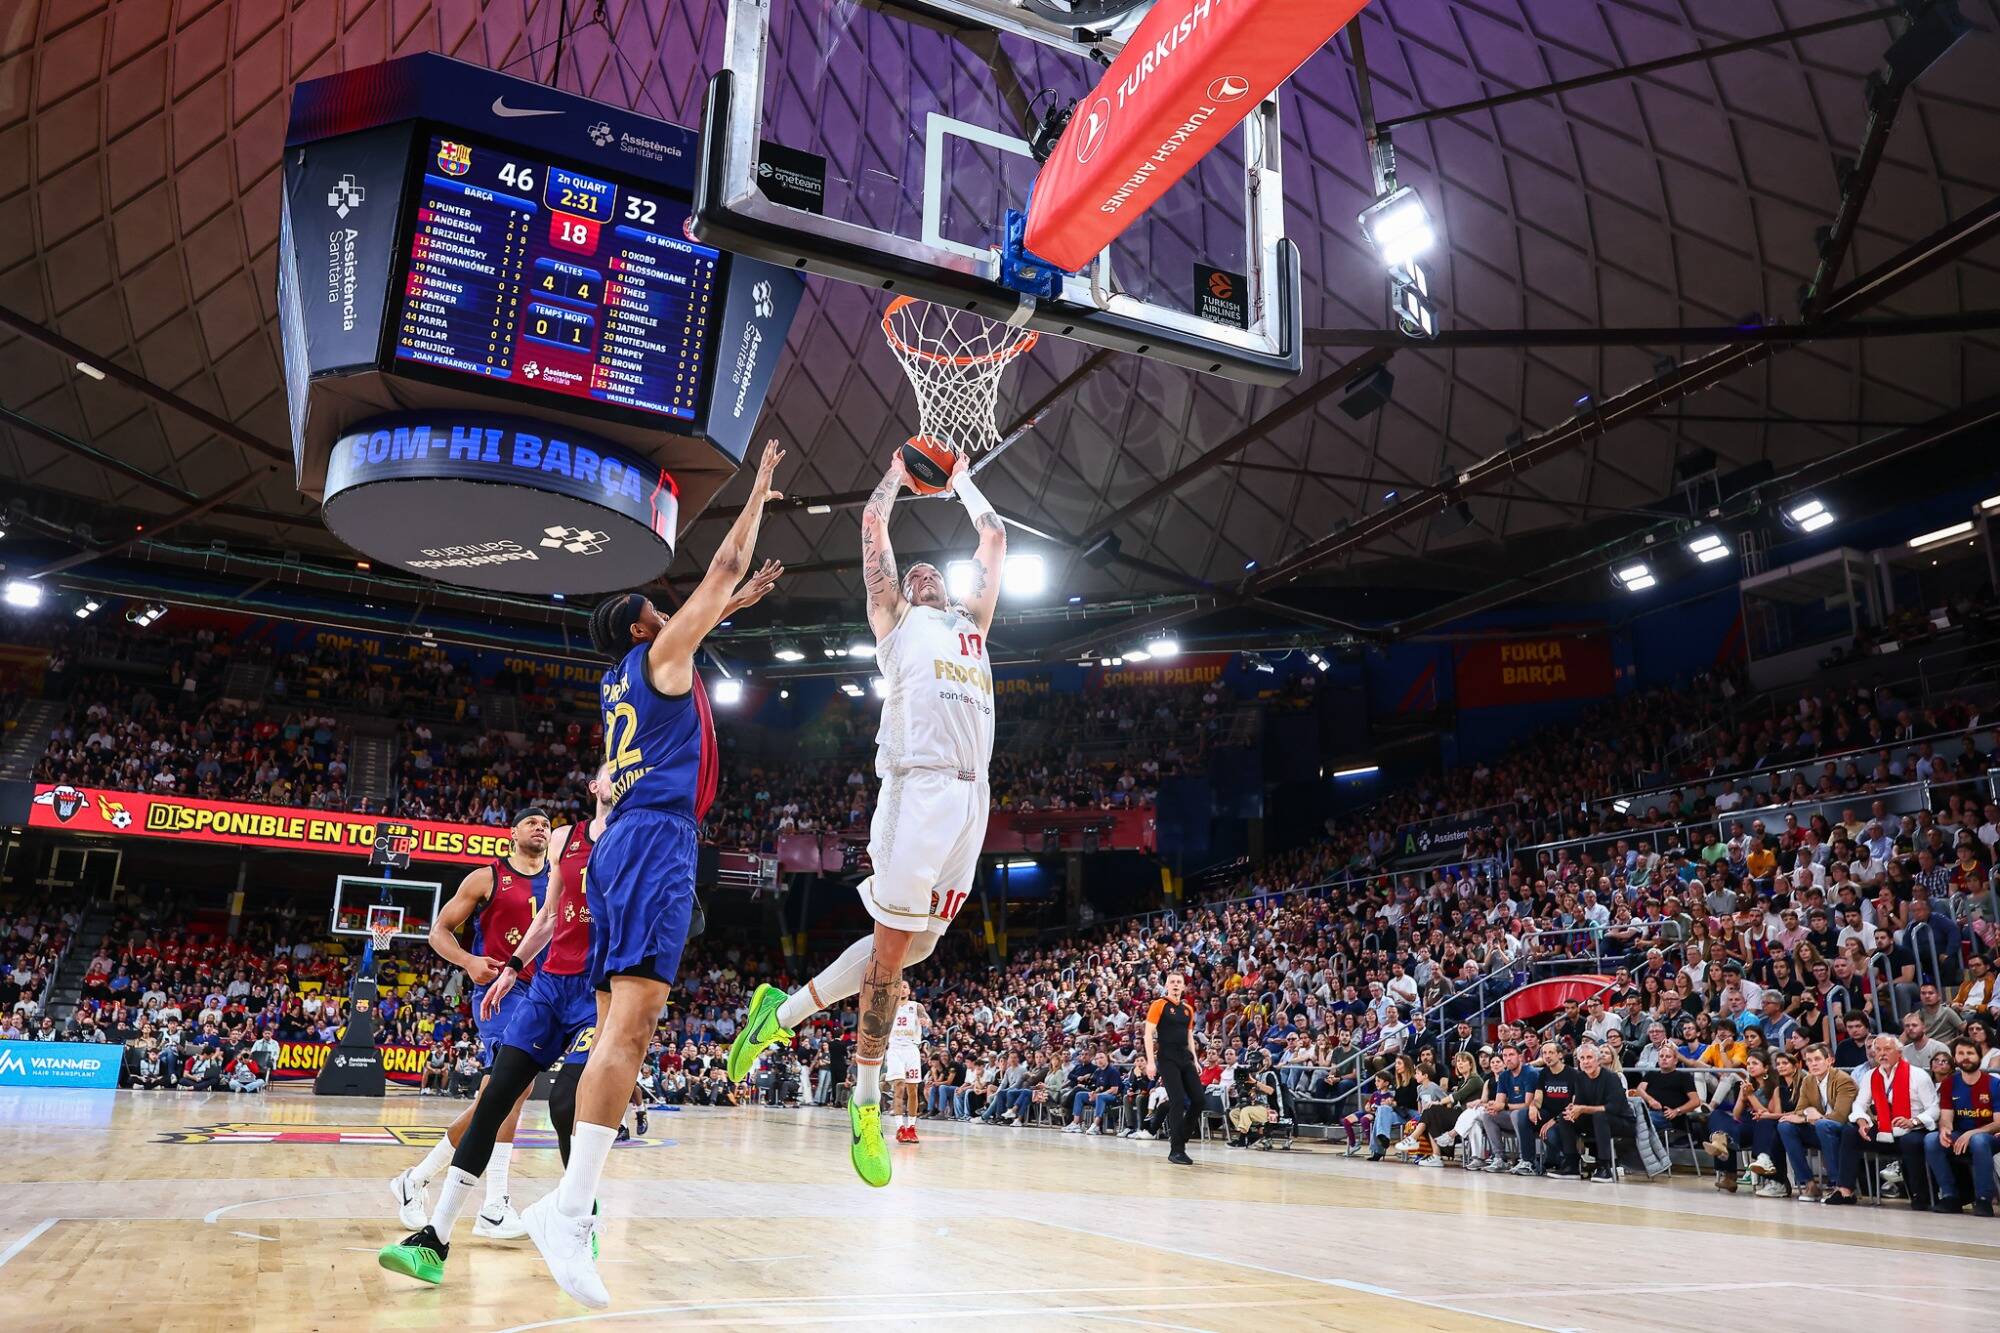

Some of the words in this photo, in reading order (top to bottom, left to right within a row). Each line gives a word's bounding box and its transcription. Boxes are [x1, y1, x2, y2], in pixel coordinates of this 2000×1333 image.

[1116, 0, 1211, 110] TURKISH
[1151, 106, 1217, 162] TURKISH
[620, 141, 663, 161] Sanitària
[621, 132, 682, 157] Assistència
[498, 162, 534, 191] 46
[557, 173, 571, 184] 2n
[572, 178, 607, 194] QUART
[775, 173, 821, 191] oneteam
[464, 187, 493, 201] BARÇA
[1100, 162, 1157, 214] AIRLINES
[436, 202, 471, 217] PUNTER
[560, 189, 597, 213] 2:31
[624, 196, 657, 225] 32
[434, 215, 482, 233] ANDERSON
[561, 221, 587, 245] 18
[432, 228, 476, 244] BRIZUELA
[645, 235, 657, 244] AS
[657, 238, 692, 253] MONACO
[420, 237, 429, 245] 13
[430, 240, 487, 260] SATORANSKY
[328, 230, 344, 303] Sanitària
[428, 252, 495, 275] HERNANGÓMEZ
[628, 252, 656, 264] OKOBO
[415, 262, 425, 271] 19
[426, 265, 447, 276] FALL
[554, 263, 583, 276] FALTES
[626, 263, 686, 285] BLOSSOMGAME
[343, 228, 359, 331] Assistència
[414, 275, 422, 283] 21
[424, 277, 463, 292] ABRINES
[543, 275, 554, 290] 4
[577, 284, 589, 299] 4
[624, 276, 645, 286] LOYD
[411, 287, 421, 296] 22
[422, 290, 456, 304] PARKER
[612, 285, 621, 293] 10
[623, 287, 646, 299] THEIS
[409, 300, 419, 308] 41
[420, 302, 445, 315] KEITA
[612, 297, 620, 305] 11
[620, 299, 649, 312] DIALLO
[1202, 295, 1240, 312] TURKISH
[1202, 304, 1241, 320] AIRLINES
[406, 312, 416, 320] 44
[418, 315, 448, 328] PARRA
[535, 305, 562, 318] TEMPS
[563, 312, 587, 324] MORT
[609, 309, 618, 317] 12
[619, 311, 658, 327] CORNELIE
[404, 325, 414, 333] 45
[416, 326, 448, 340] VILLAR
[536, 319, 548, 335] 0
[572, 328, 581, 343] 1
[607, 321, 616, 329] 14
[617, 323, 645, 336] JAITEH
[401, 338, 413, 346] 46
[414, 340, 455, 355] GRUJICIC
[613, 346, 644, 360] TARPEY
[615, 335, 666, 353] MOTIEJUNAS
[732, 320, 755, 385] Sanitària
[412, 352, 432, 360] JOAN
[434, 356, 477, 371] PEÑARROYA
[611, 359, 642, 371] BROWN
[610, 370, 644, 384] STRAZEL
[733, 327, 763, 419] Assistència
[597, 380, 607, 388] 55
[607, 382, 635, 395] JAMES
[351, 425, 504, 470] SOM-HI
[512, 432, 641, 503] BARÇA
[958, 632, 982, 660] 10
[1501, 642, 1562, 663] FORÇA
[1502, 665, 1566, 686] BARÇA
[149, 802, 303, 840] DISPONIBLE
[308, 816, 342, 843] EN
[423, 829, 460, 852] LES
[466, 833, 515, 857] SEC
[393, 838, 410, 853] 18
[1405, 833, 1417, 854] A
[897, 1016, 907, 1026] 32
[31, 1057, 101, 1070] VATANMED
[52, 1070, 96, 1078] TRANSPLANT
[909, 1069, 919, 1079] 32
